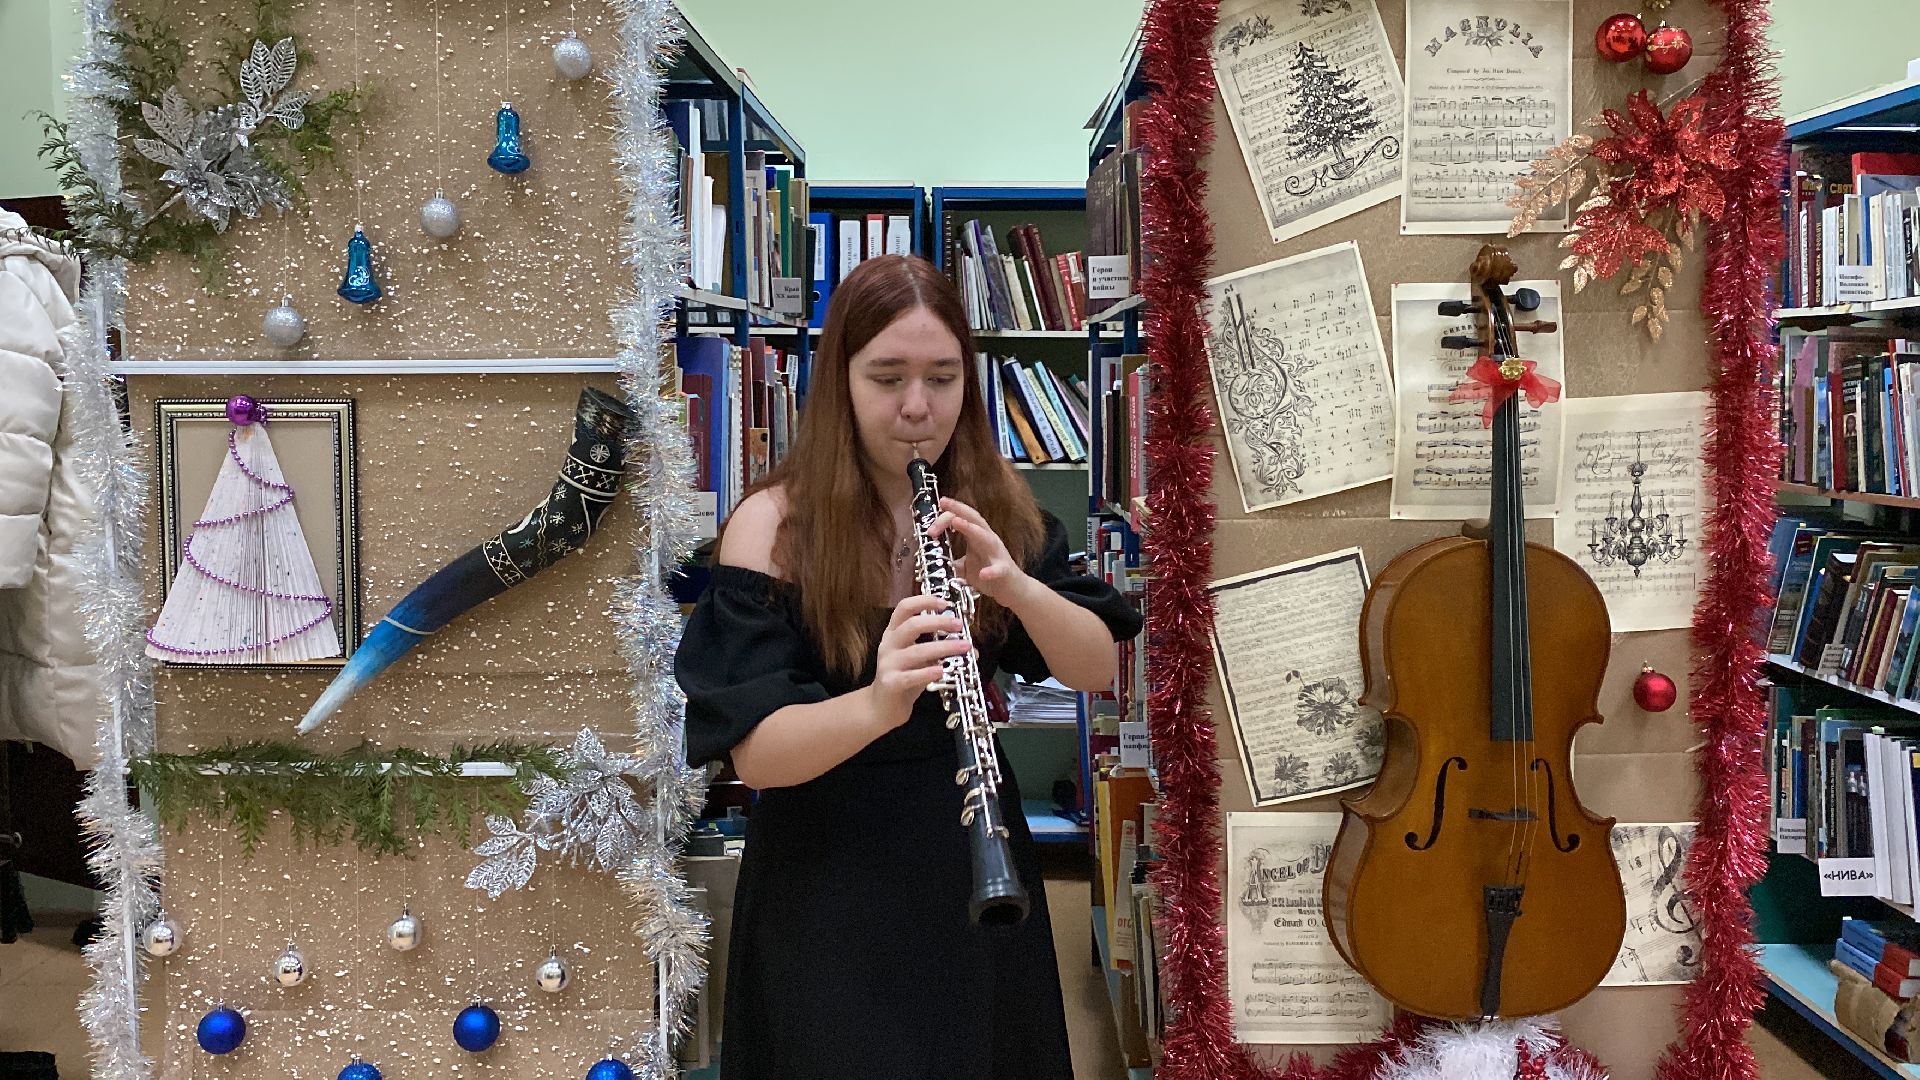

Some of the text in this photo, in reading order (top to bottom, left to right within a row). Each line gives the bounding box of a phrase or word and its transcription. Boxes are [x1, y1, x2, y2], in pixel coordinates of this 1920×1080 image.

[1424, 16, 1543, 58] MAGNOLIA
[1241, 857, 1297, 907] ANGEL
[1823, 870, 1874, 881] «НИВА»
